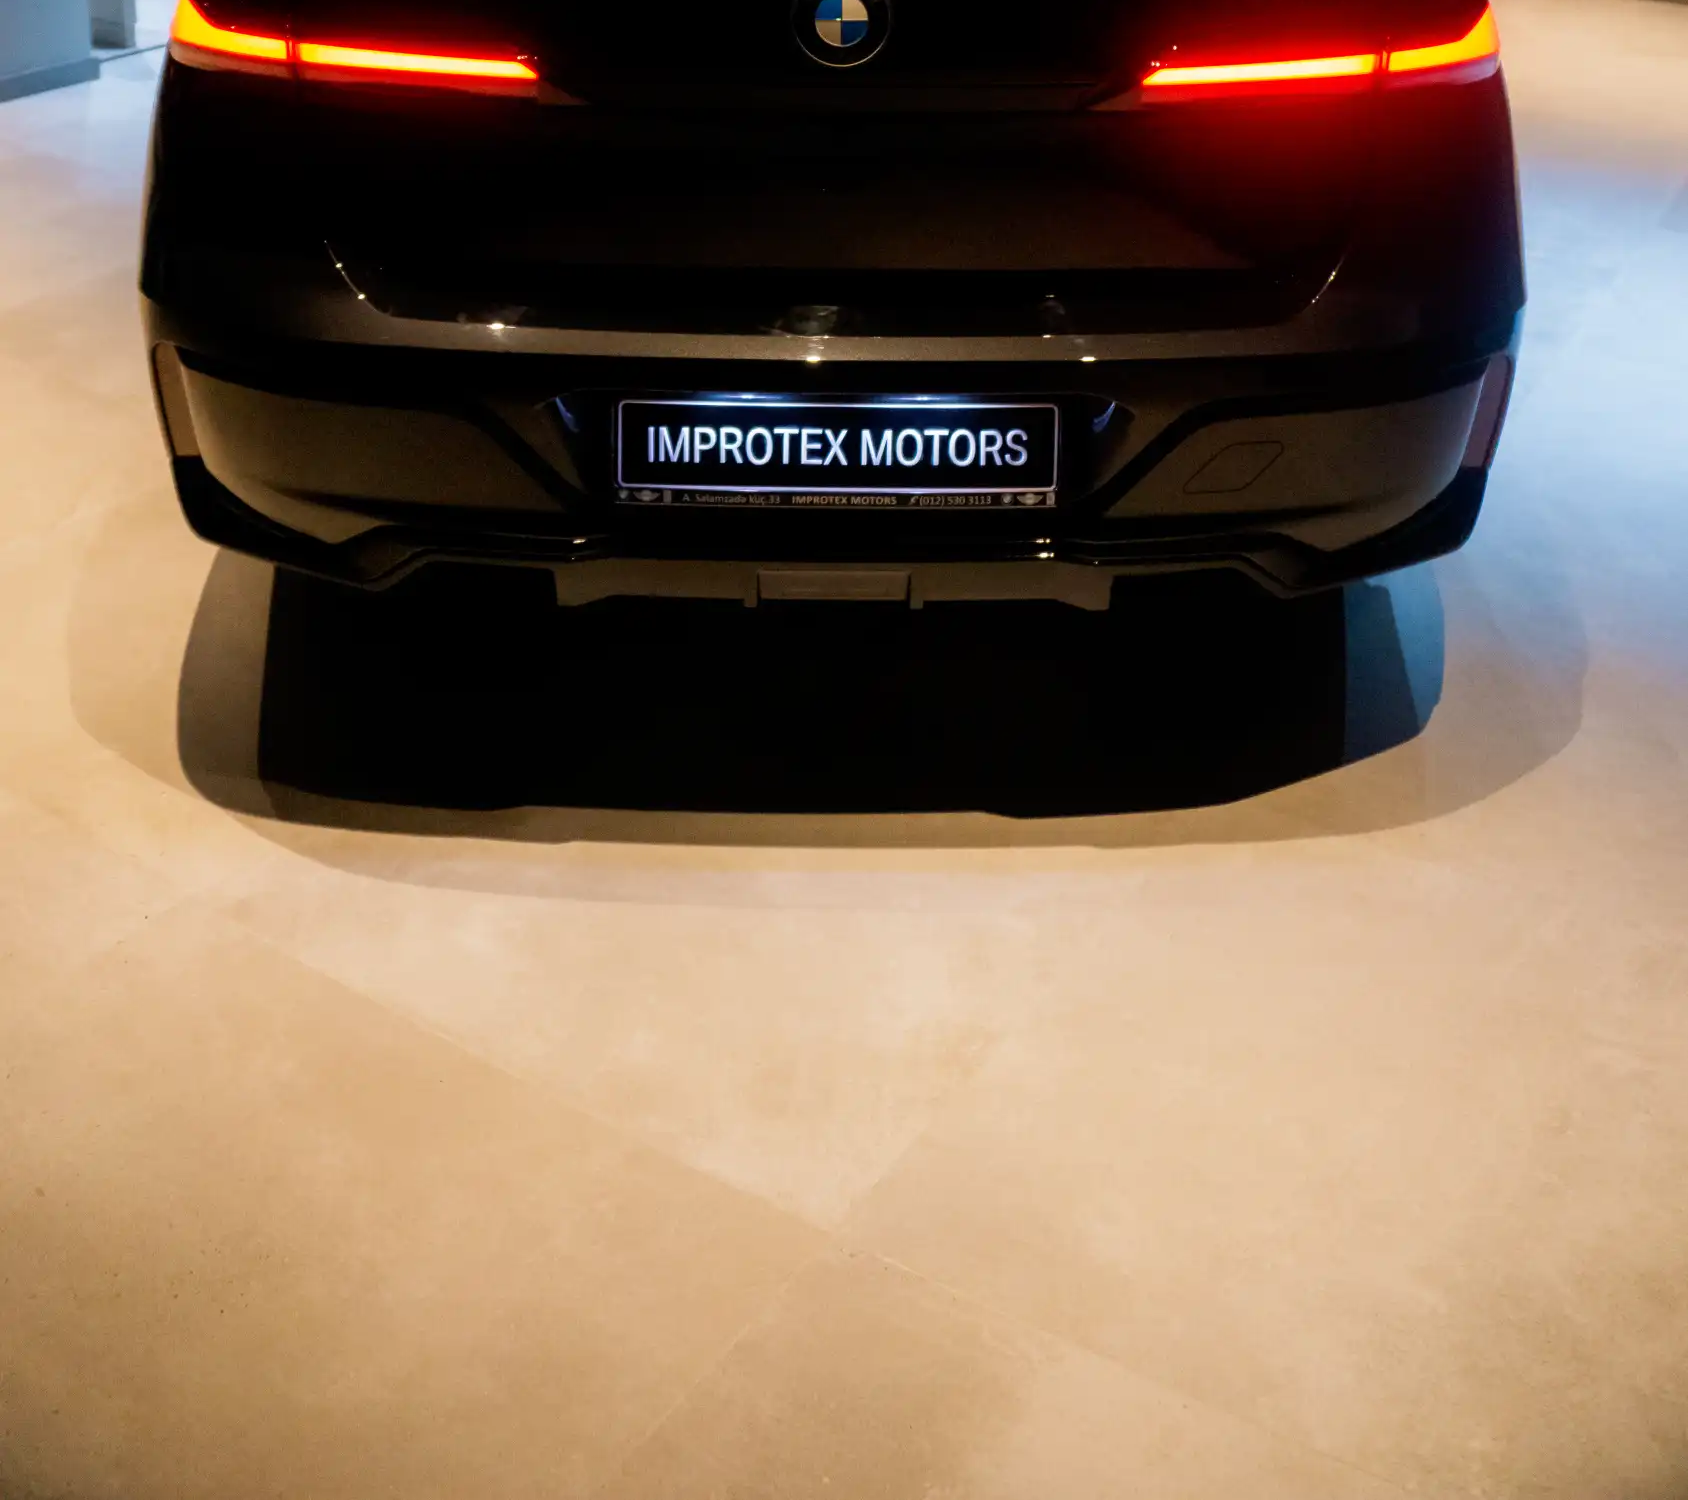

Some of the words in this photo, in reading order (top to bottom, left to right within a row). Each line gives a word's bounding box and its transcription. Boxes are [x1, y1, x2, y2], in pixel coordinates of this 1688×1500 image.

[647, 426, 848, 466] IMPROTEX
[861, 429, 1028, 467] MOTORS
[792, 495, 848, 505] IMPROTEX
[850, 496, 898, 505] MOTORS
